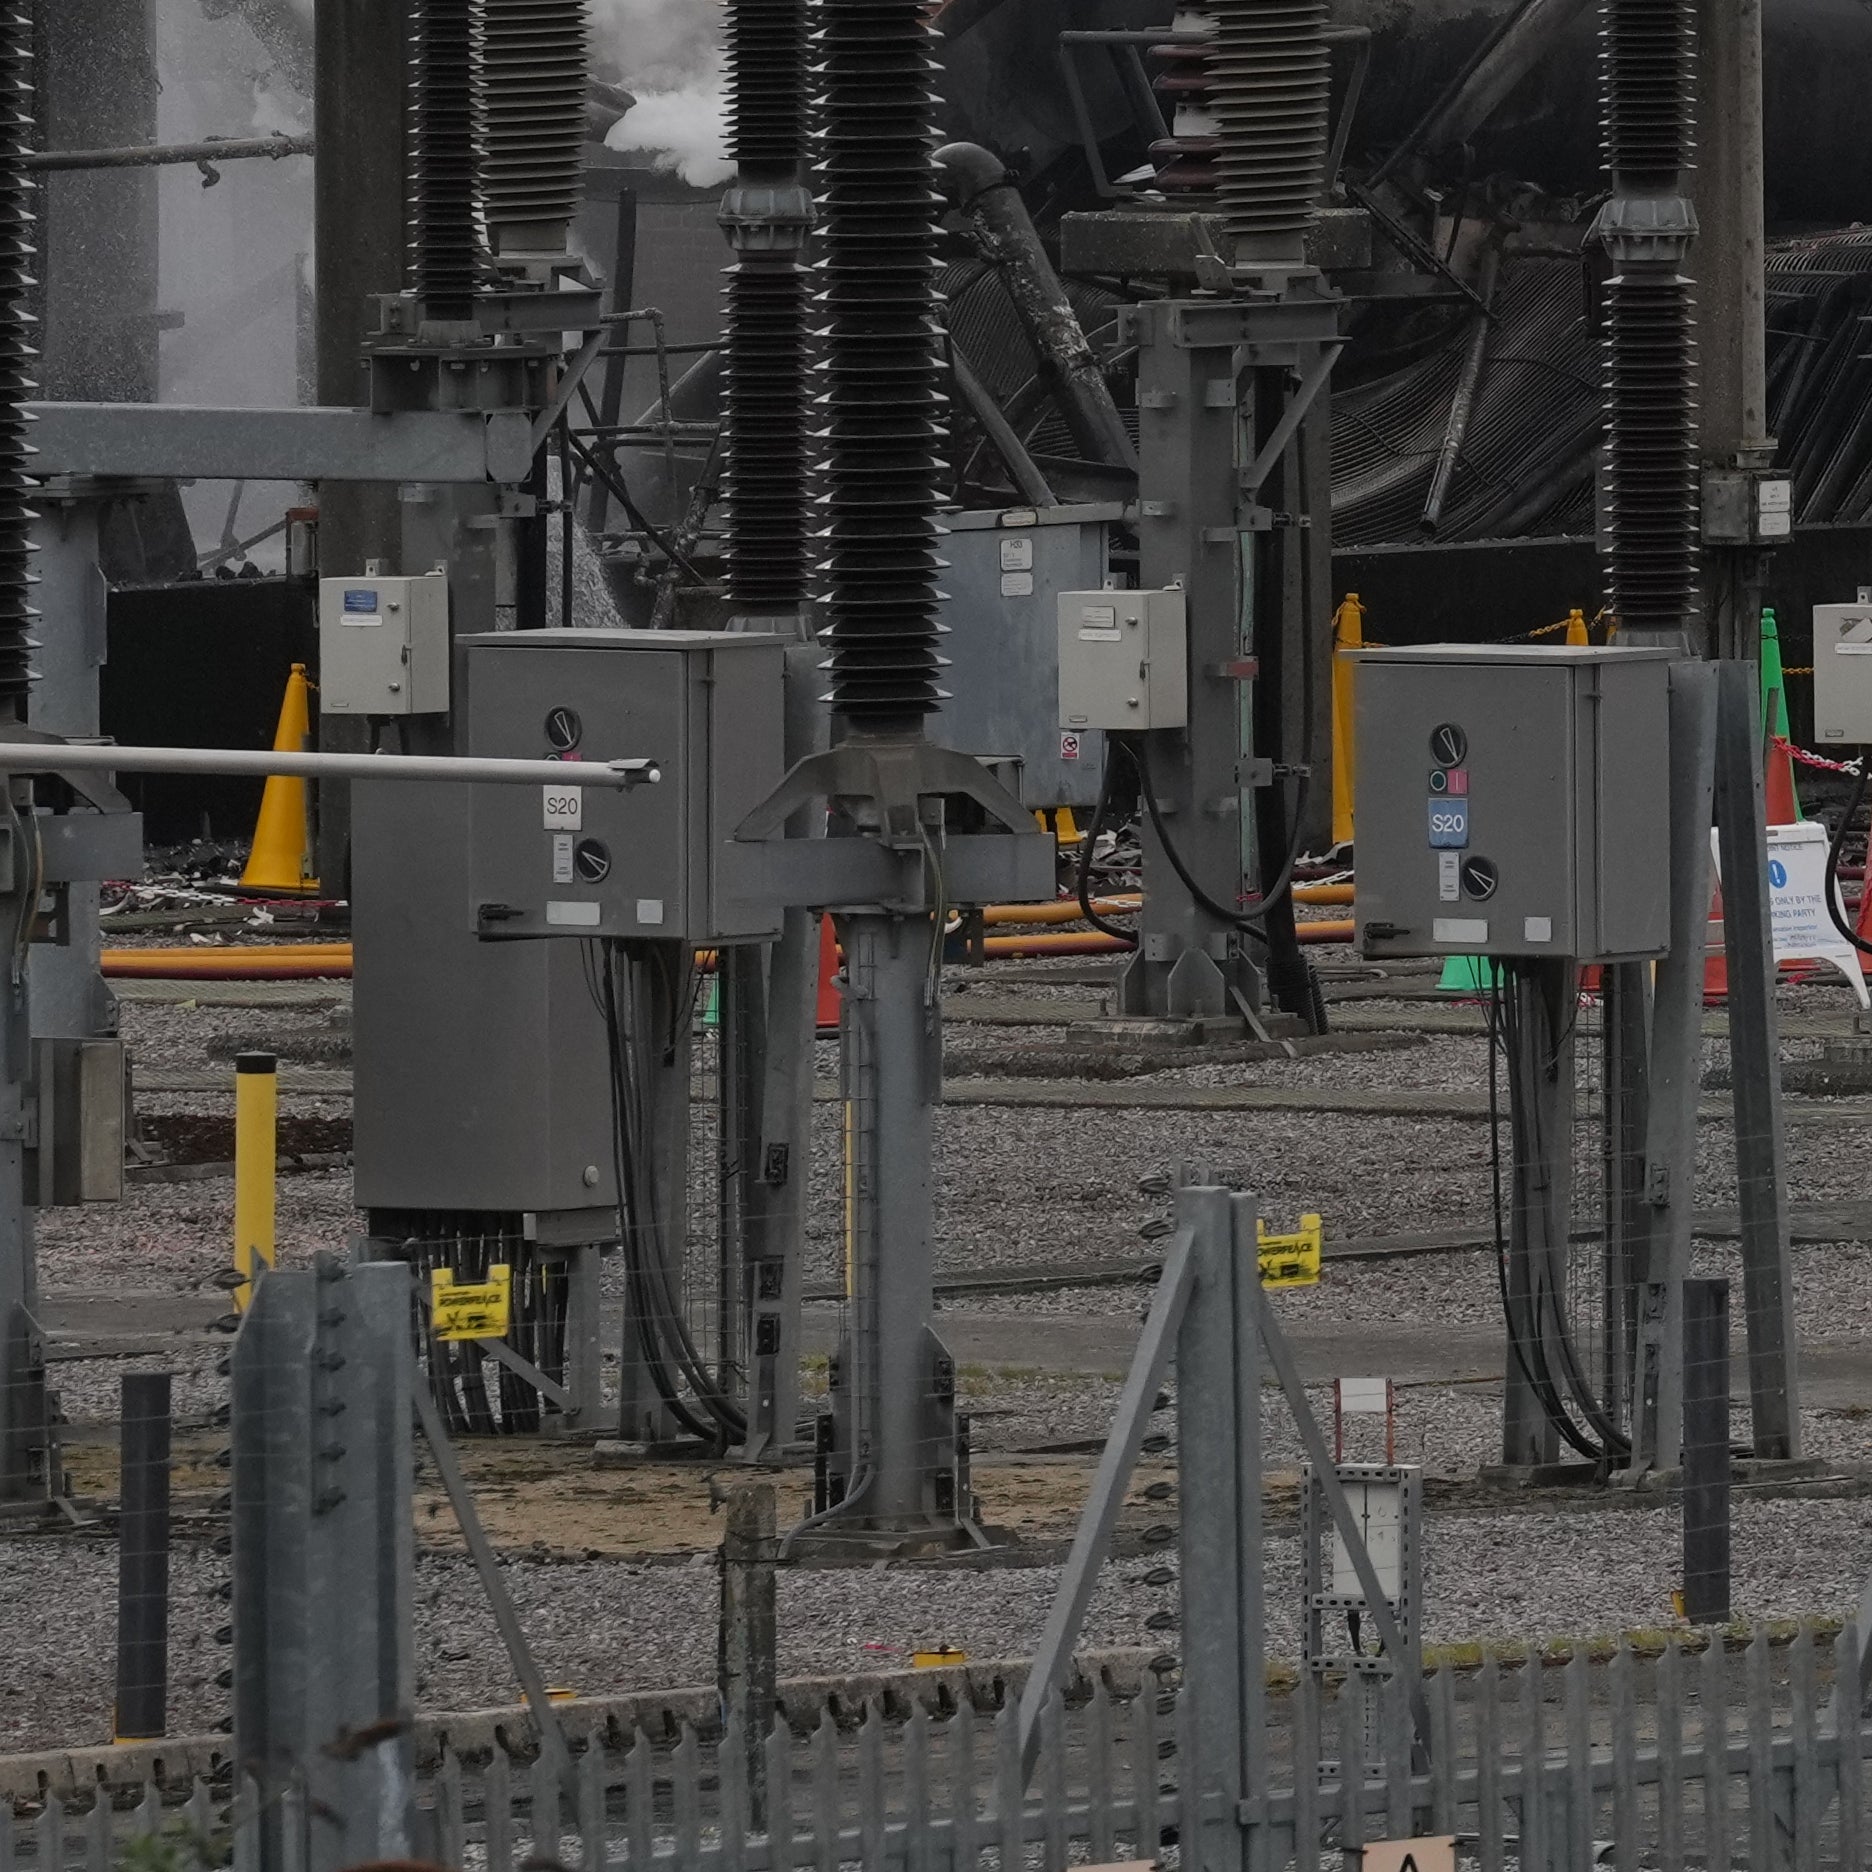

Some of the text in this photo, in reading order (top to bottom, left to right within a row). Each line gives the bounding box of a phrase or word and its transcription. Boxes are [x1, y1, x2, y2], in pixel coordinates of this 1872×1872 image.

[546, 797, 578, 815] S20
[1432, 814, 1465, 832] S20
[1775, 896, 1794, 906] ONLY
[1796, 895, 1806, 904] BY
[1793, 908, 1816, 918] PARTY
